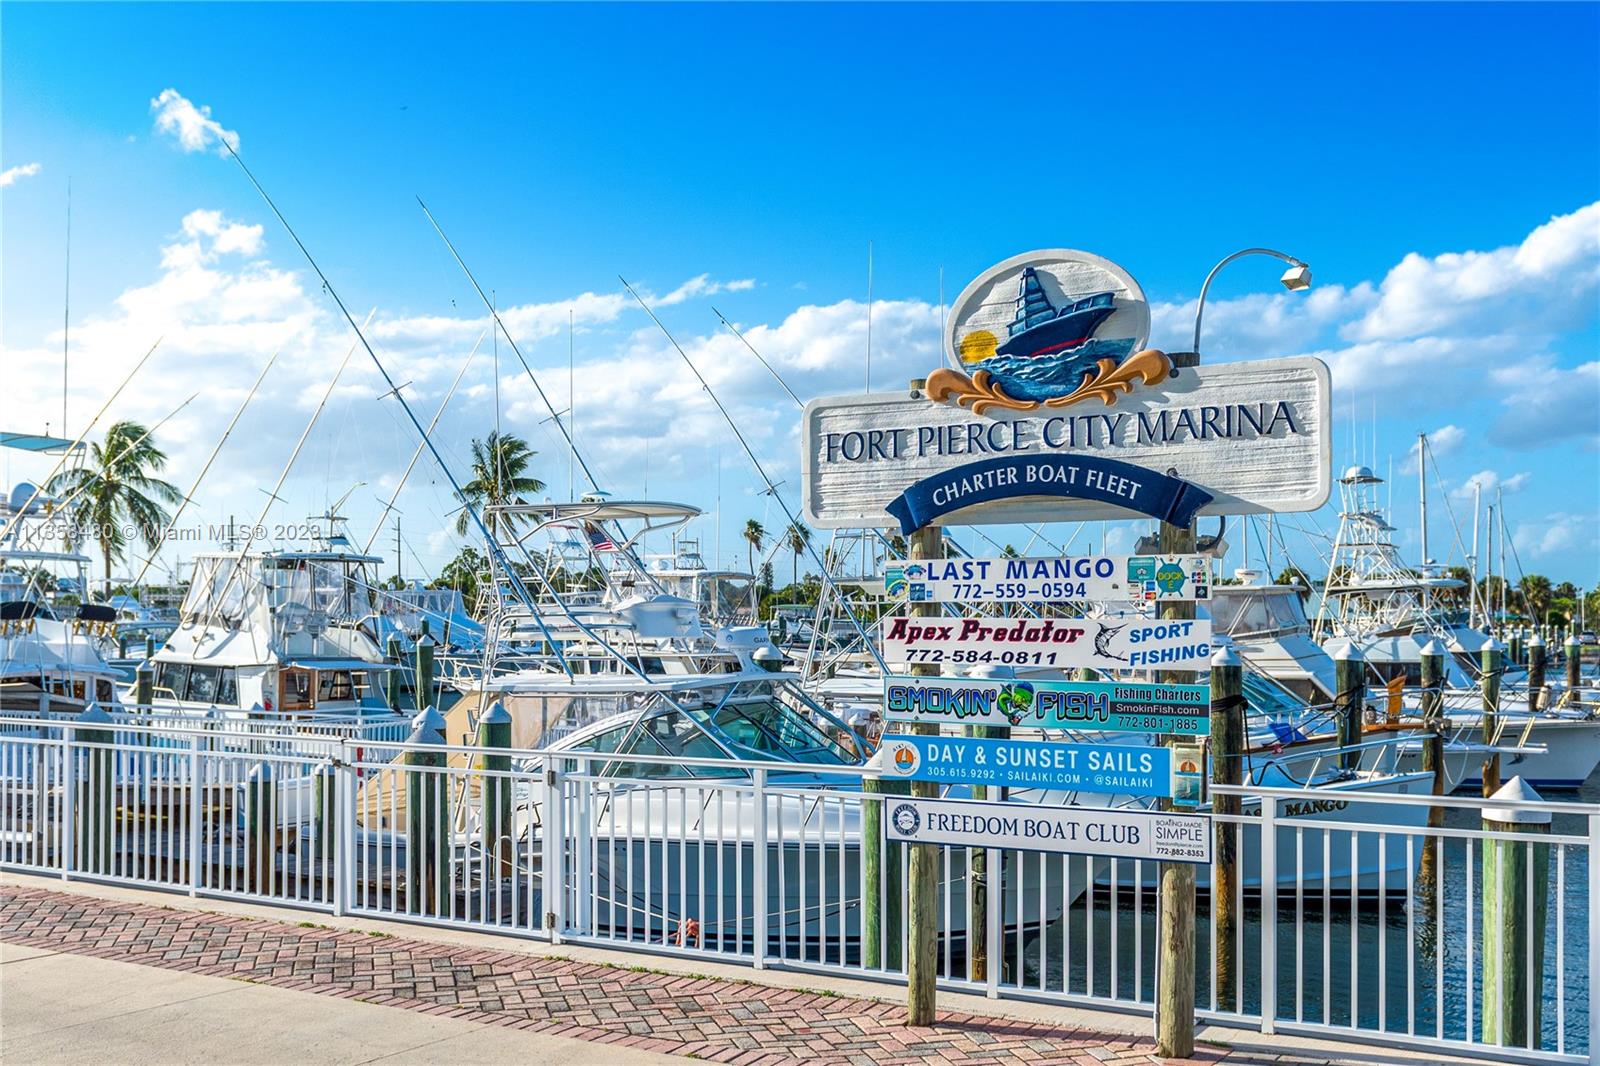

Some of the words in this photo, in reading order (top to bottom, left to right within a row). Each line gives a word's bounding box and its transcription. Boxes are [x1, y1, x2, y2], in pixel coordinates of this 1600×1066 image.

[826, 429, 905, 462] FORT
[918, 420, 1030, 457] PIERCE
[1043, 413, 1125, 449] CITY
[1136, 401, 1298, 444] MARINA
[932, 467, 1017, 506] CHARTER
[1025, 464, 1080, 484] BOAT
[1085, 469, 1142, 501] FLEET
[928, 561, 991, 581] LAST
[1005, 558, 1114, 580] MANGO
[1158, 571, 1182, 580] DOCK
[952, 582, 1087, 599] 772-559-0594
[1167, 580, 1174, 589] E
[887, 618, 953, 645] Apex
[957, 619, 1085, 644] Predator
[1129, 621, 1194, 644] SPORT
[905, 649, 1057, 665] 772-584-0811
[1129, 643, 1210, 667] FISHING
[888, 685, 997, 718] SMOKIN'
[1035, 691, 1110, 722] FISH
[1115, 687, 1152, 701] Fishing
[1155, 688, 1201, 701] Charters
[1116, 703, 1200, 715] SmokinFish.com
[1118, 716, 1198, 730] 772-801-1885
[927, 743, 966, 764] DAY
[974, 746, 987, 765] &
[995, 747, 1079, 769] SUNSET
[1088, 751, 1153, 774] SAILS
[927, 766, 995, 780] 305.615.9292
[1007, 771, 1081, 784] SAILAIKI.COM
[1094, 775, 1153, 788] @SAILAIKI
[1285, 799, 1349, 817] MANGO
[927, 813, 1019, 836] FREEDOM
[1023, 819, 1080, 841] BOAT
[1085, 823, 1141, 845] CLUB
[1156, 819, 1182, 827] BOATING
[1156, 826, 1203, 842] SIMPLE
